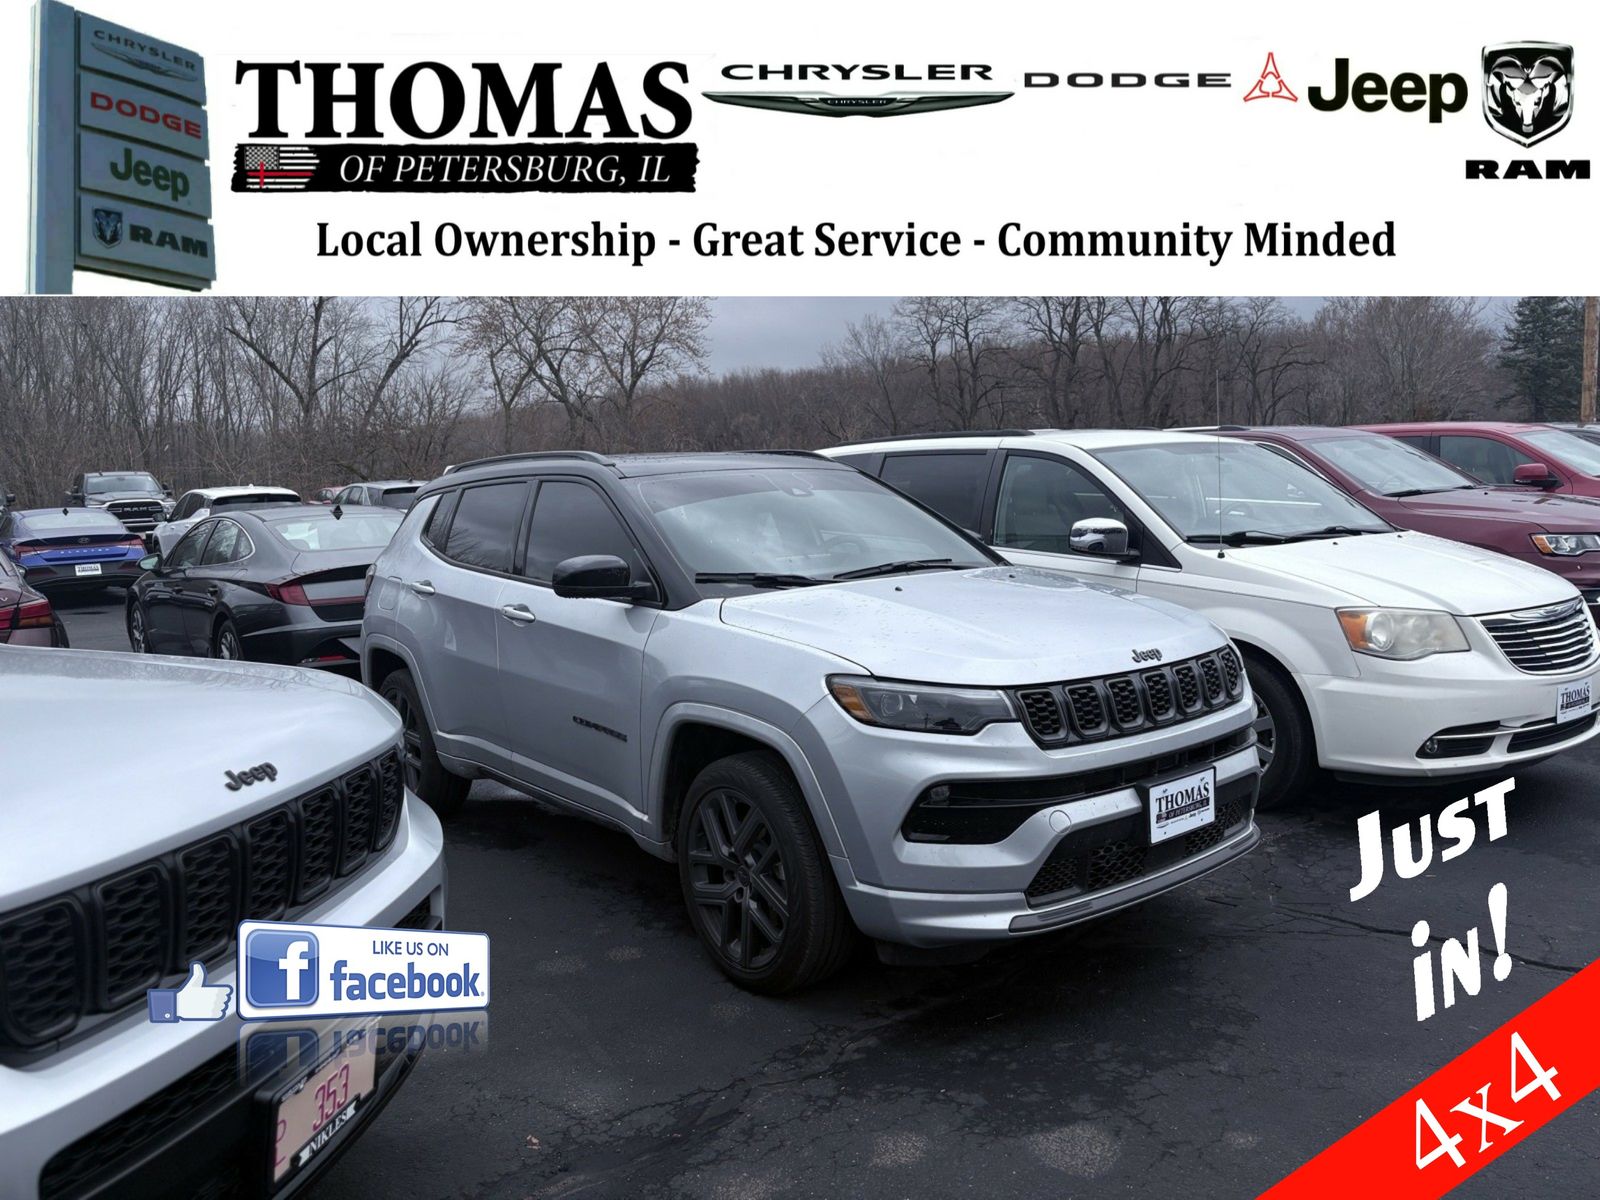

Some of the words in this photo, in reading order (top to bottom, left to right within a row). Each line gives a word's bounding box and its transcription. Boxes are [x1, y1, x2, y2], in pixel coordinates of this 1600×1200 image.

[1131, 648, 1163, 663] Jeep
[1560, 685, 1590, 704] THOMAS
[224, 762, 278, 792] Jeep
[1155, 782, 1210, 813] THOMAS
[312, 1063, 350, 1132] 353
[309, 1111, 348, 1156] NIKLES
